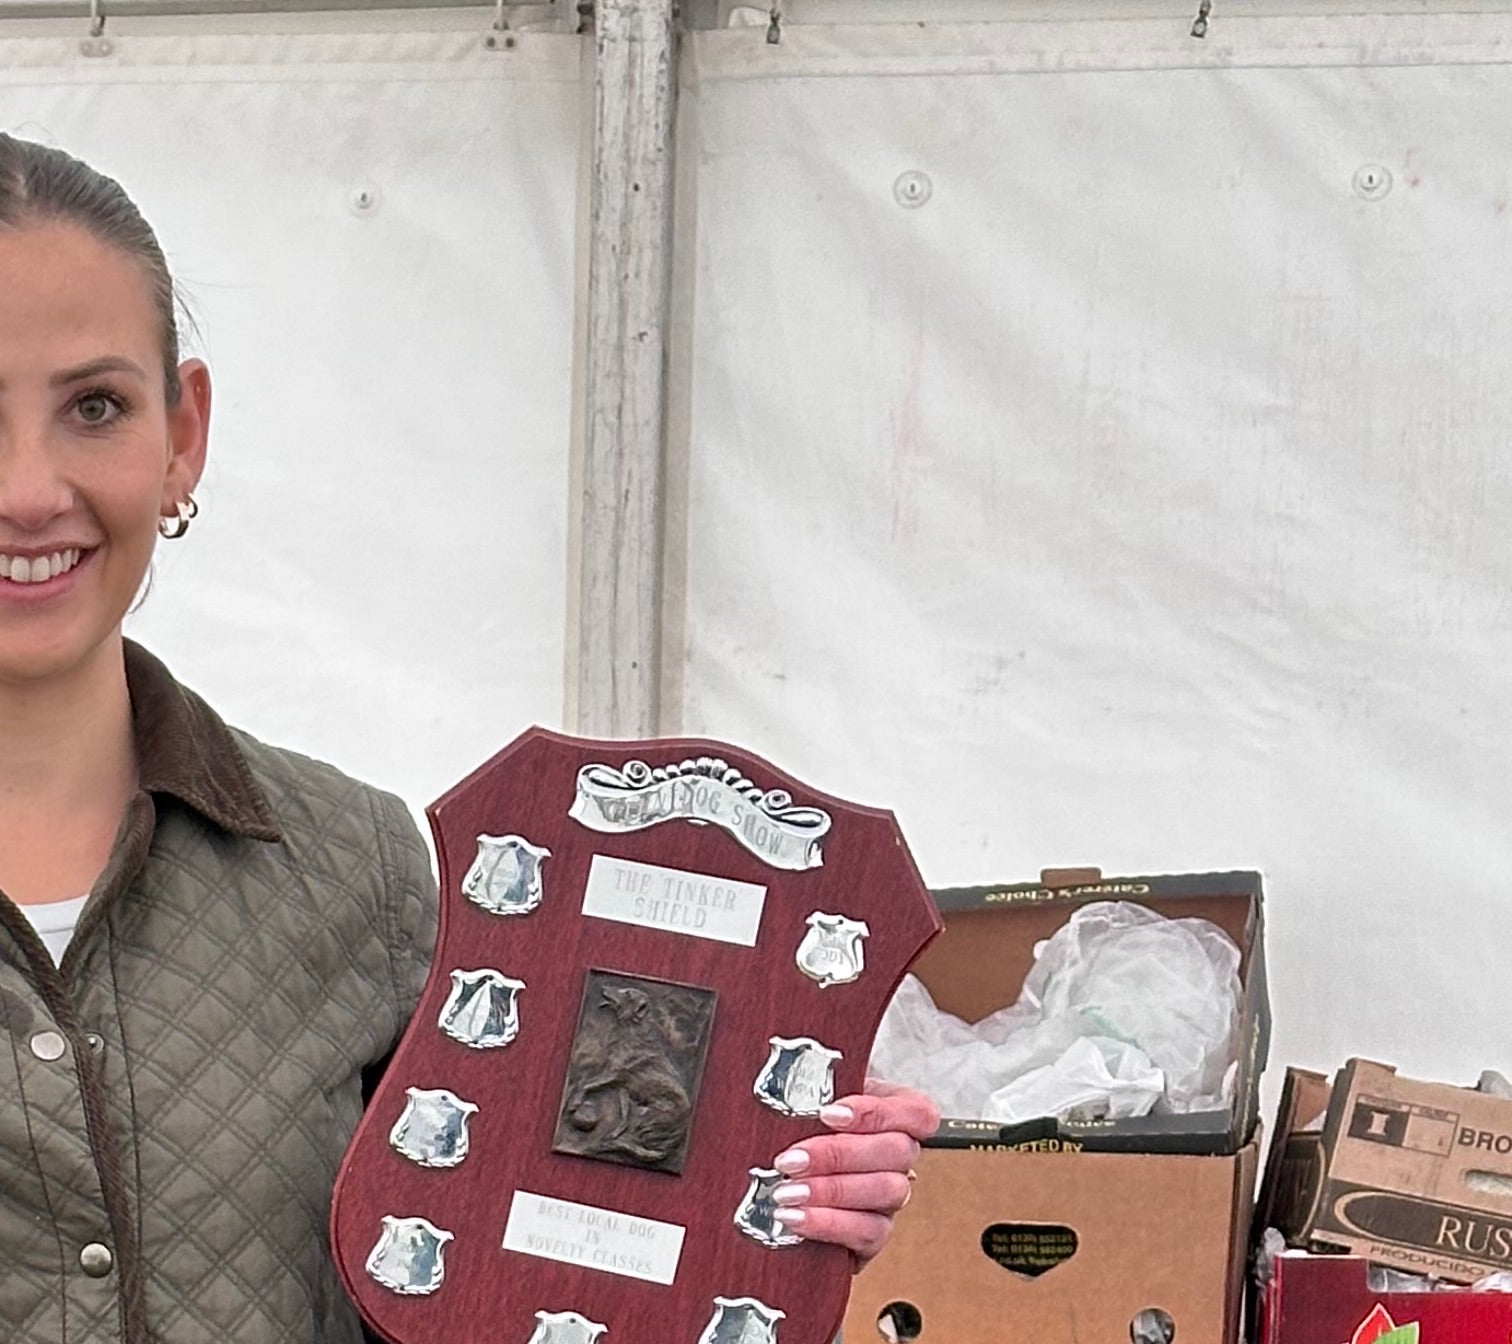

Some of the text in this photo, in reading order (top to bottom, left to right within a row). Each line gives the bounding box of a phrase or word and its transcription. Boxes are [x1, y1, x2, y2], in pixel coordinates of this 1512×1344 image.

[730, 803, 785, 855] SHOW
[614, 867, 737, 911] THE TINKER
[632, 896, 707, 929] SHIELD
[538, 1200, 656, 1240] BEST LOCAL DOG
[585, 1229, 601, 1245] IN
[526, 1233, 653, 1274] NOVELTY CLASSES
[1369, 1245, 1485, 1277] PRODUCIDO
